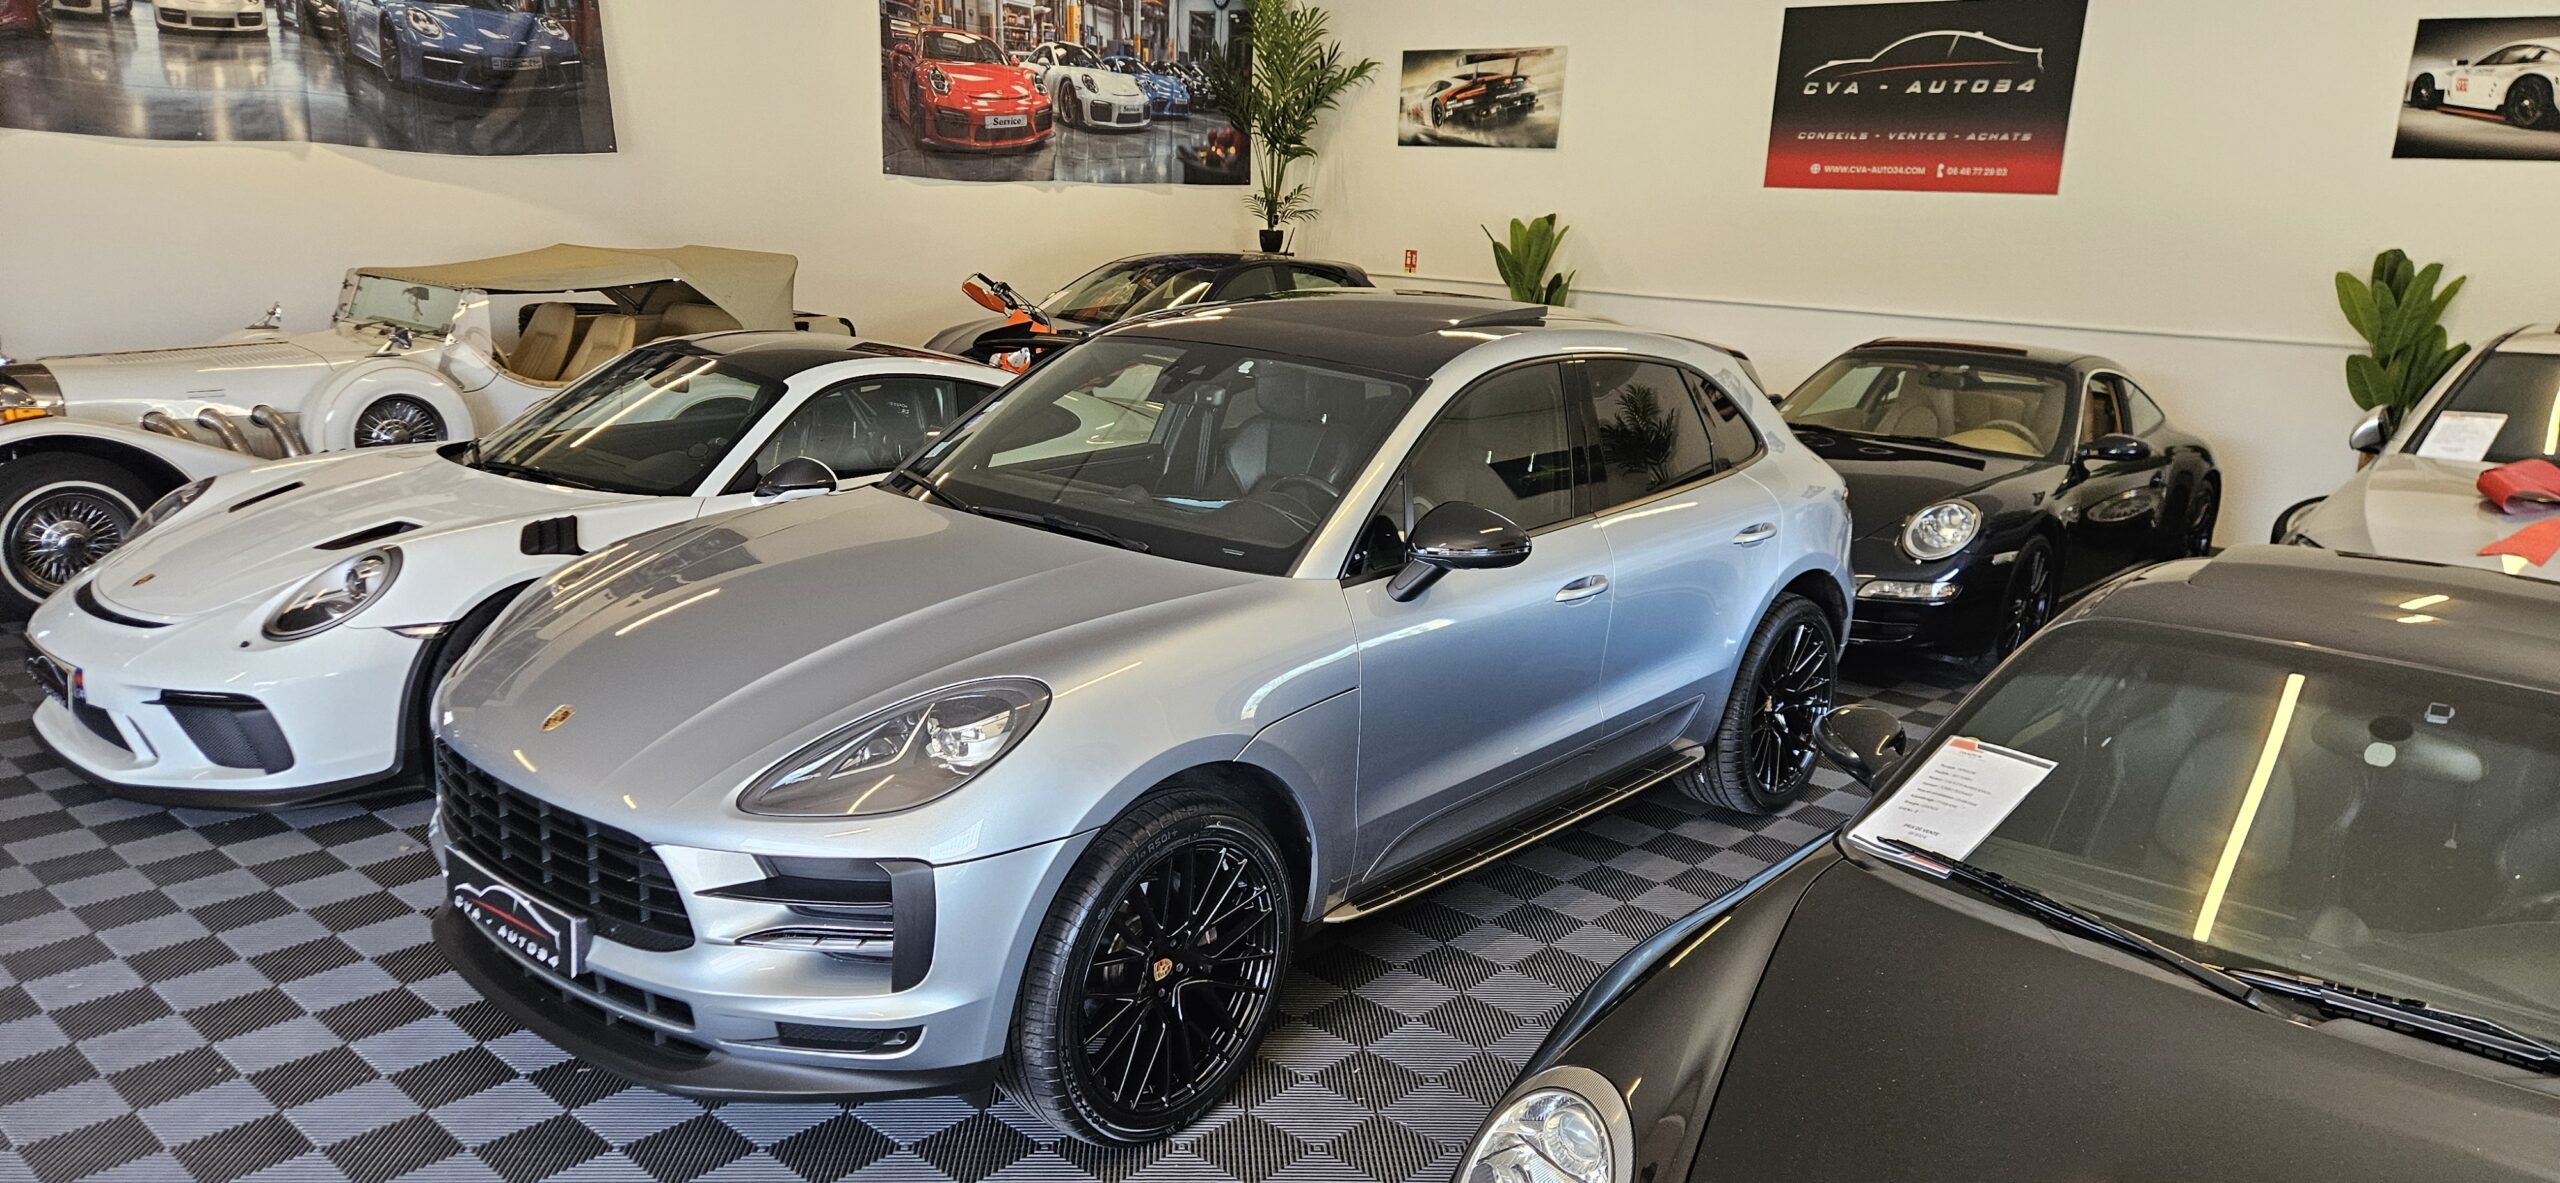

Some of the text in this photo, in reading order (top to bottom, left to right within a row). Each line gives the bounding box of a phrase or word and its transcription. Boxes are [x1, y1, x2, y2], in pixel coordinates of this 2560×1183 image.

[1803, 81, 1859, 95] CVA
[1905, 79, 2036, 94] AUTO34
[993, 117, 1021, 126] Service
[1797, 131, 1868, 140] CONSEILS
[1888, 131, 1947, 140] VENTES
[1966, 131, 2032, 141] ACHATS
[1824, 165, 1926, 175] WWW.CVA-AUTO34.COM
[455, 895, 481, 921] CVA
[497, 924, 560, 969] AUTO34
